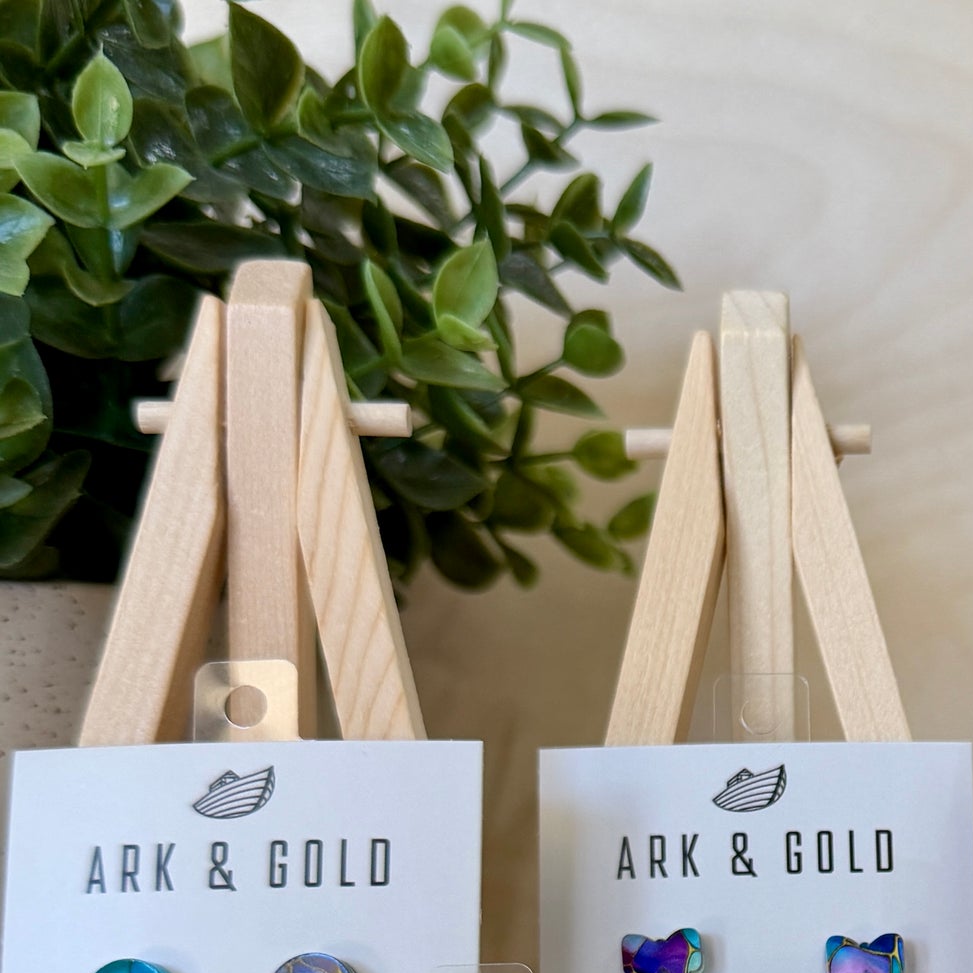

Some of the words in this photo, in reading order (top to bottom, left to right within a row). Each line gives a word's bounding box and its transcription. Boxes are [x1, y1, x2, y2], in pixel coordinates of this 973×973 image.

[86, 843, 175, 894] ARK
[208, 842, 236, 891] &
[269, 839, 390, 888] GOLD
[617, 834, 699, 880] ARK
[732, 833, 757, 877] &
[786, 830, 893, 874] GOLD
